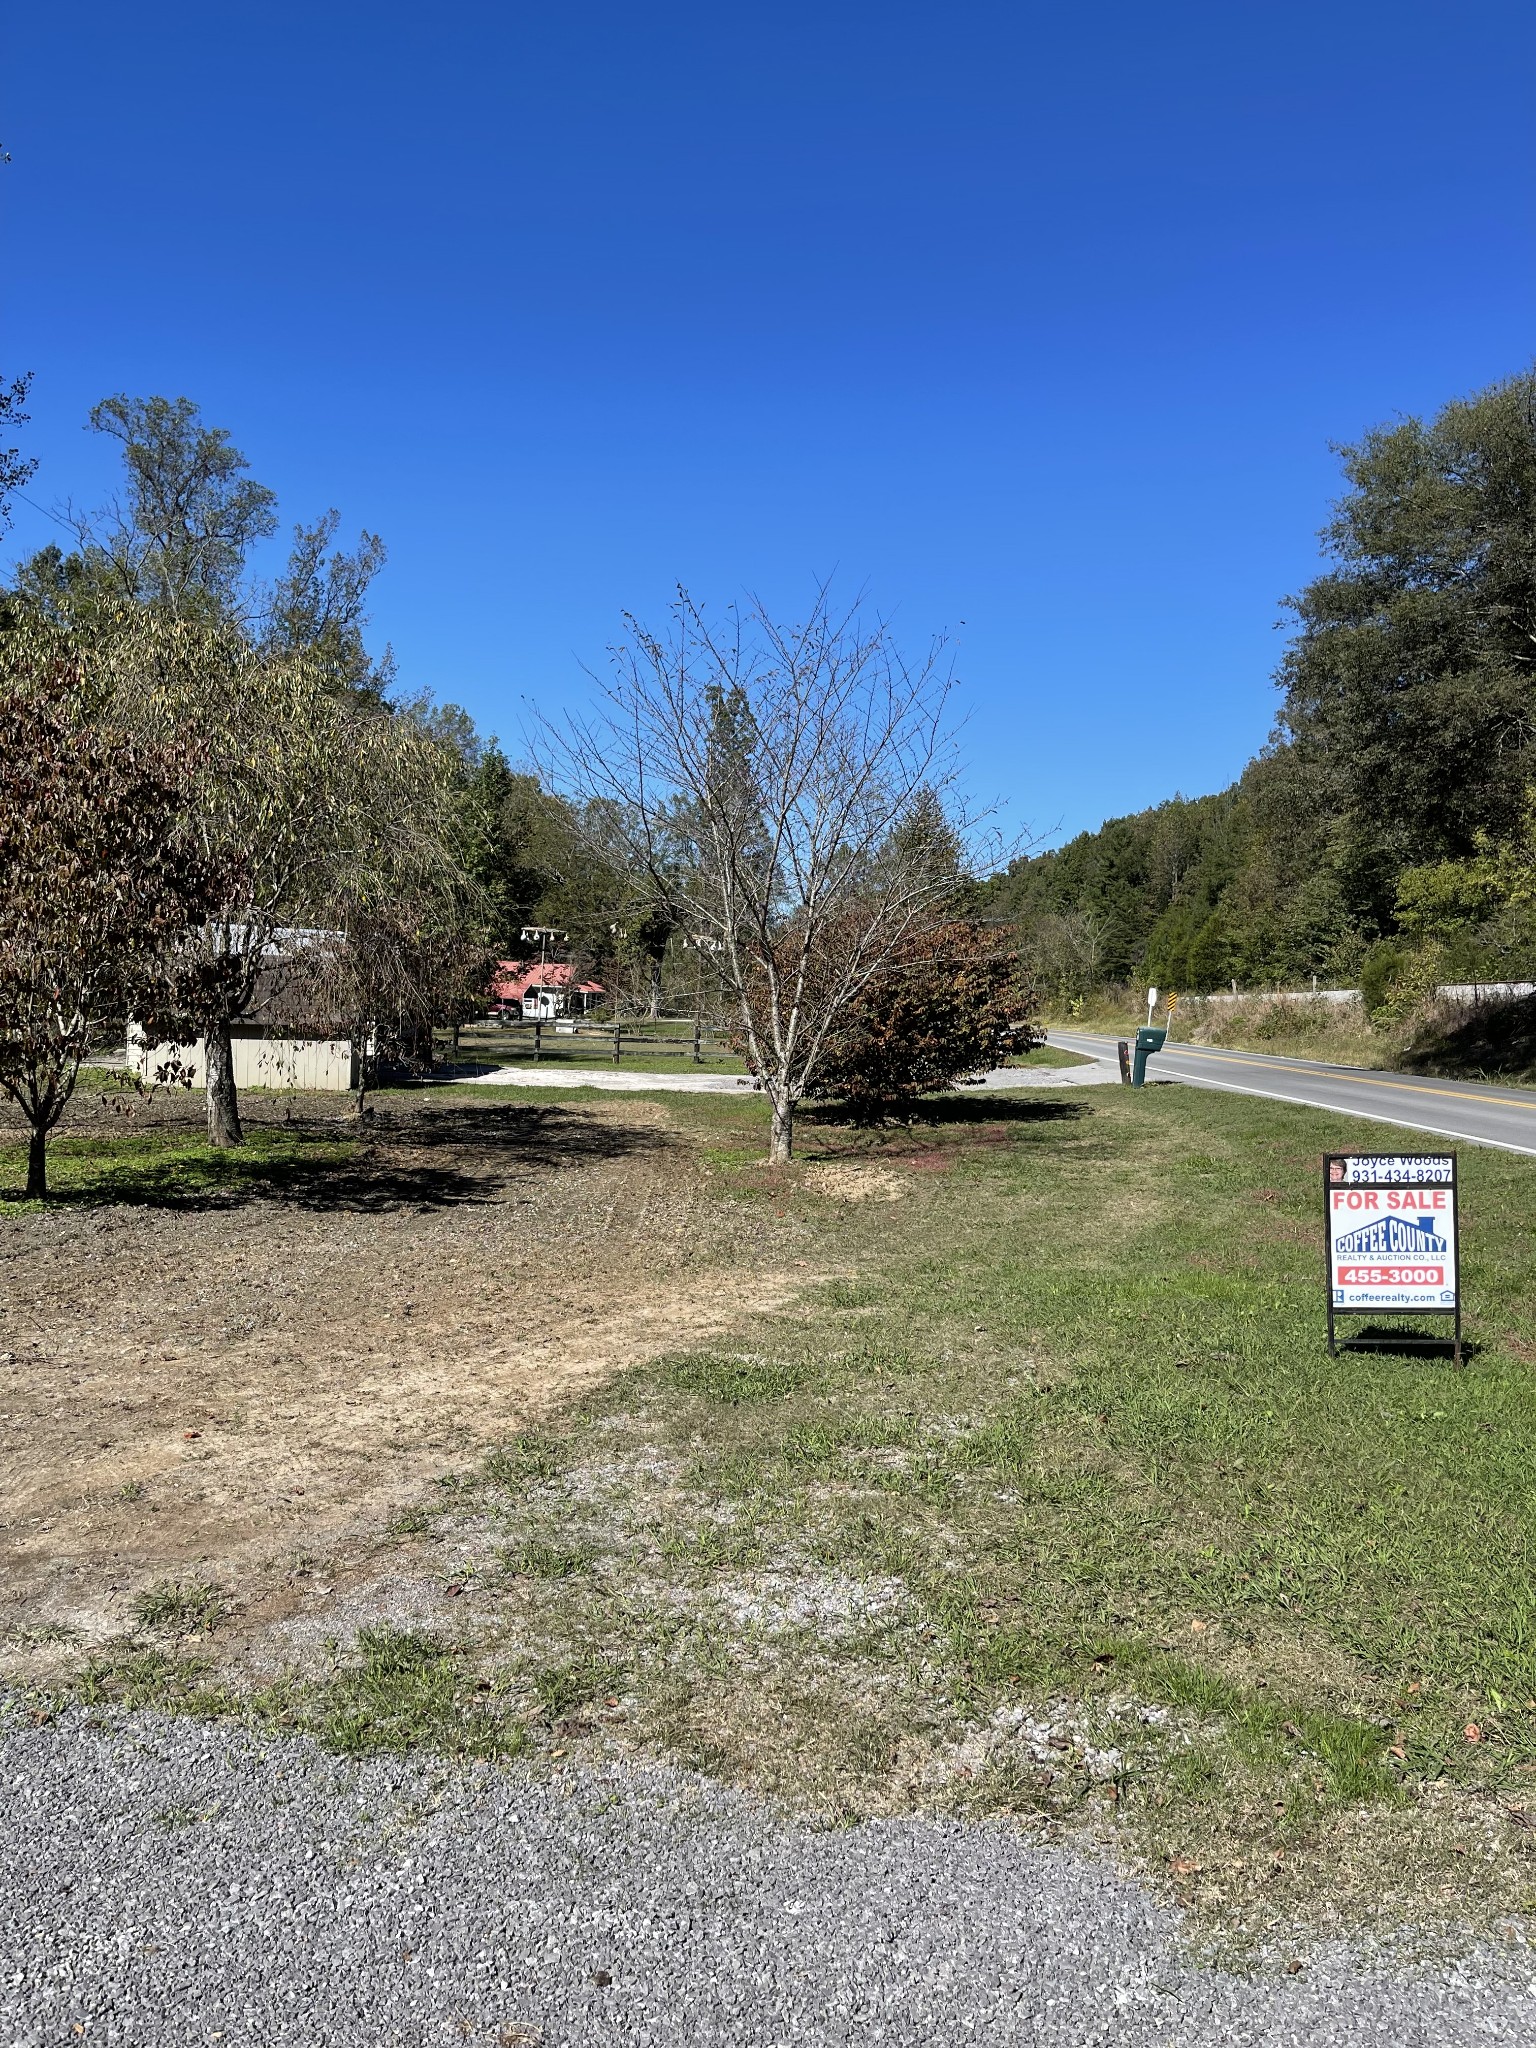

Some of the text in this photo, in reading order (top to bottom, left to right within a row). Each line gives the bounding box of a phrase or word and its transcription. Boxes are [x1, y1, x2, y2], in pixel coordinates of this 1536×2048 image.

[1352, 1157, 1449, 1168] Joyce Woods
[1352, 1169, 1451, 1182] 931-434-8207
[1333, 1191, 1446, 1210] FOR SALE
[1337, 1219, 1444, 1252] COFFEE COUNTY
[1344, 1269, 1439, 1283] 455-3000
[1349, 1293, 1435, 1303] coffeerealty.com
